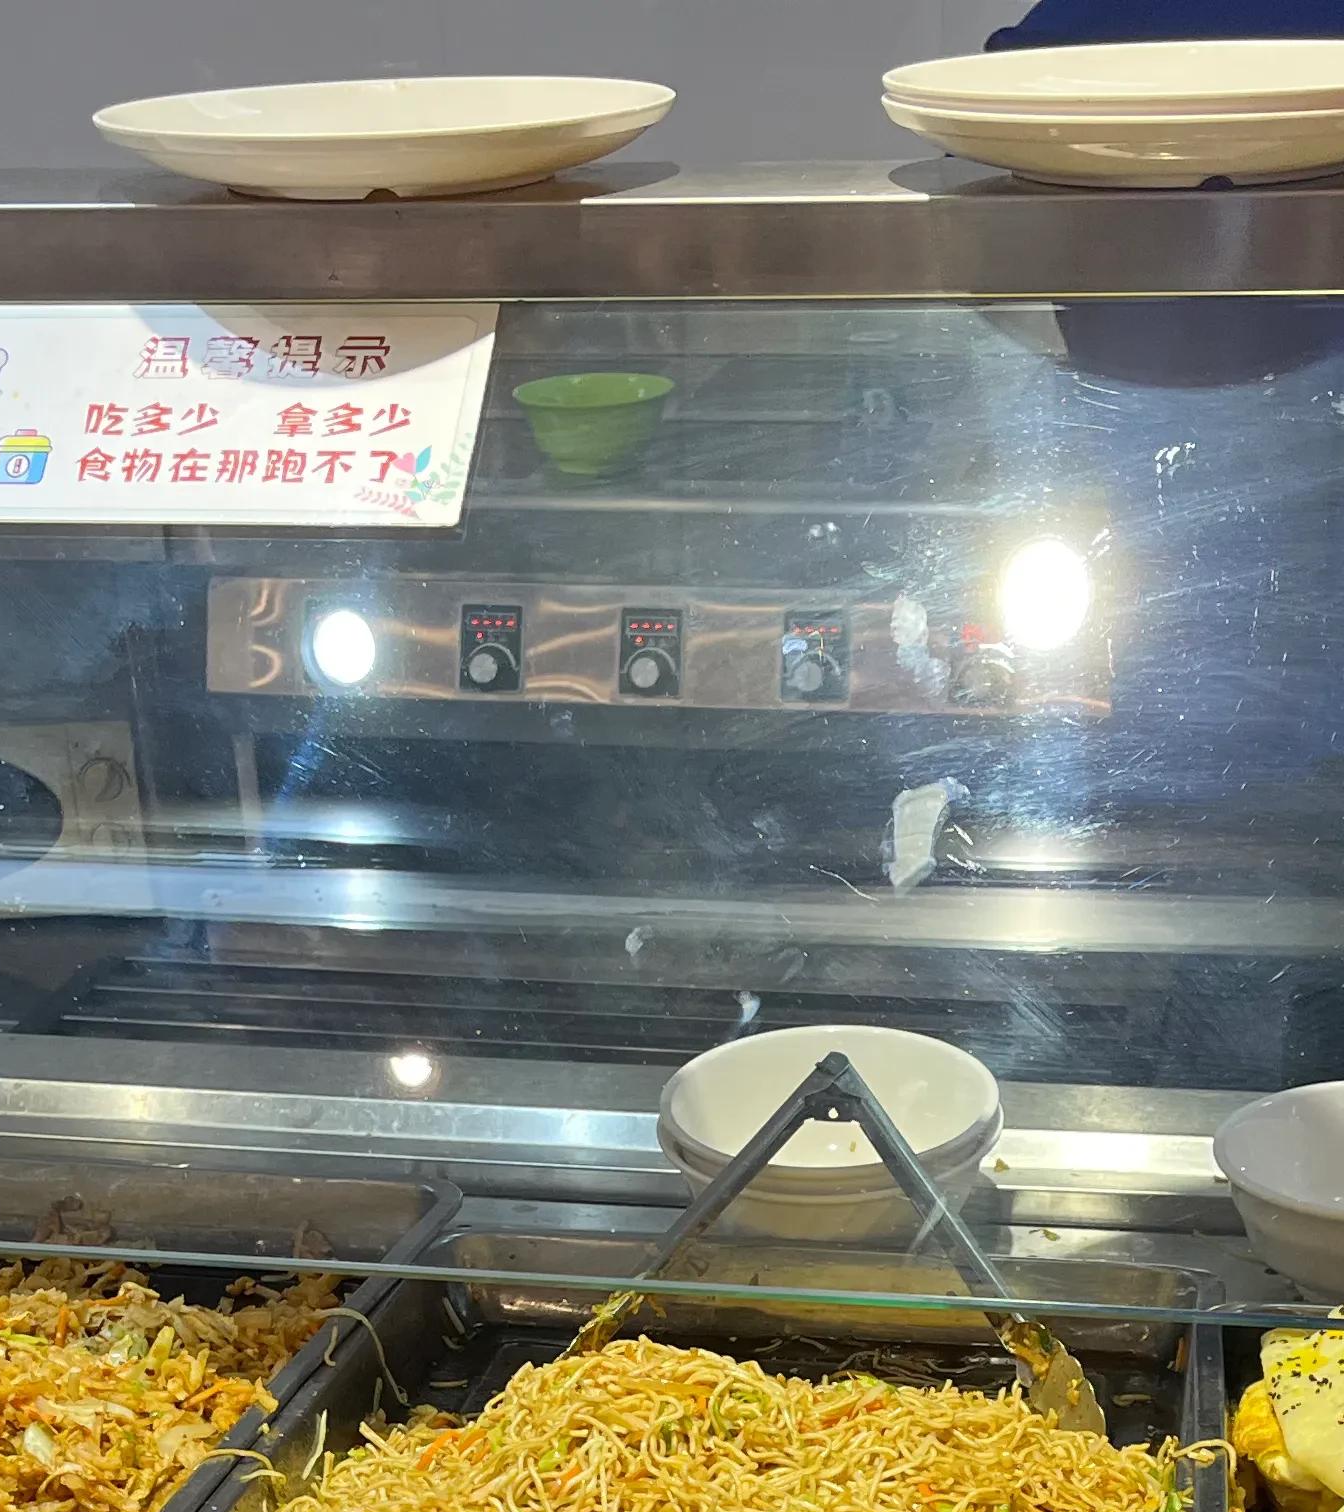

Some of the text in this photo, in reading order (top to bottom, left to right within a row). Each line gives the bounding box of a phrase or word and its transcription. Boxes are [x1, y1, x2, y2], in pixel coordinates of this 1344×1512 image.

[133, 335, 391, 379] 温馨提示
[83, 402, 412, 437] 吃多少 拿多少
[76, 447, 398, 484] 食物在那跑不了
